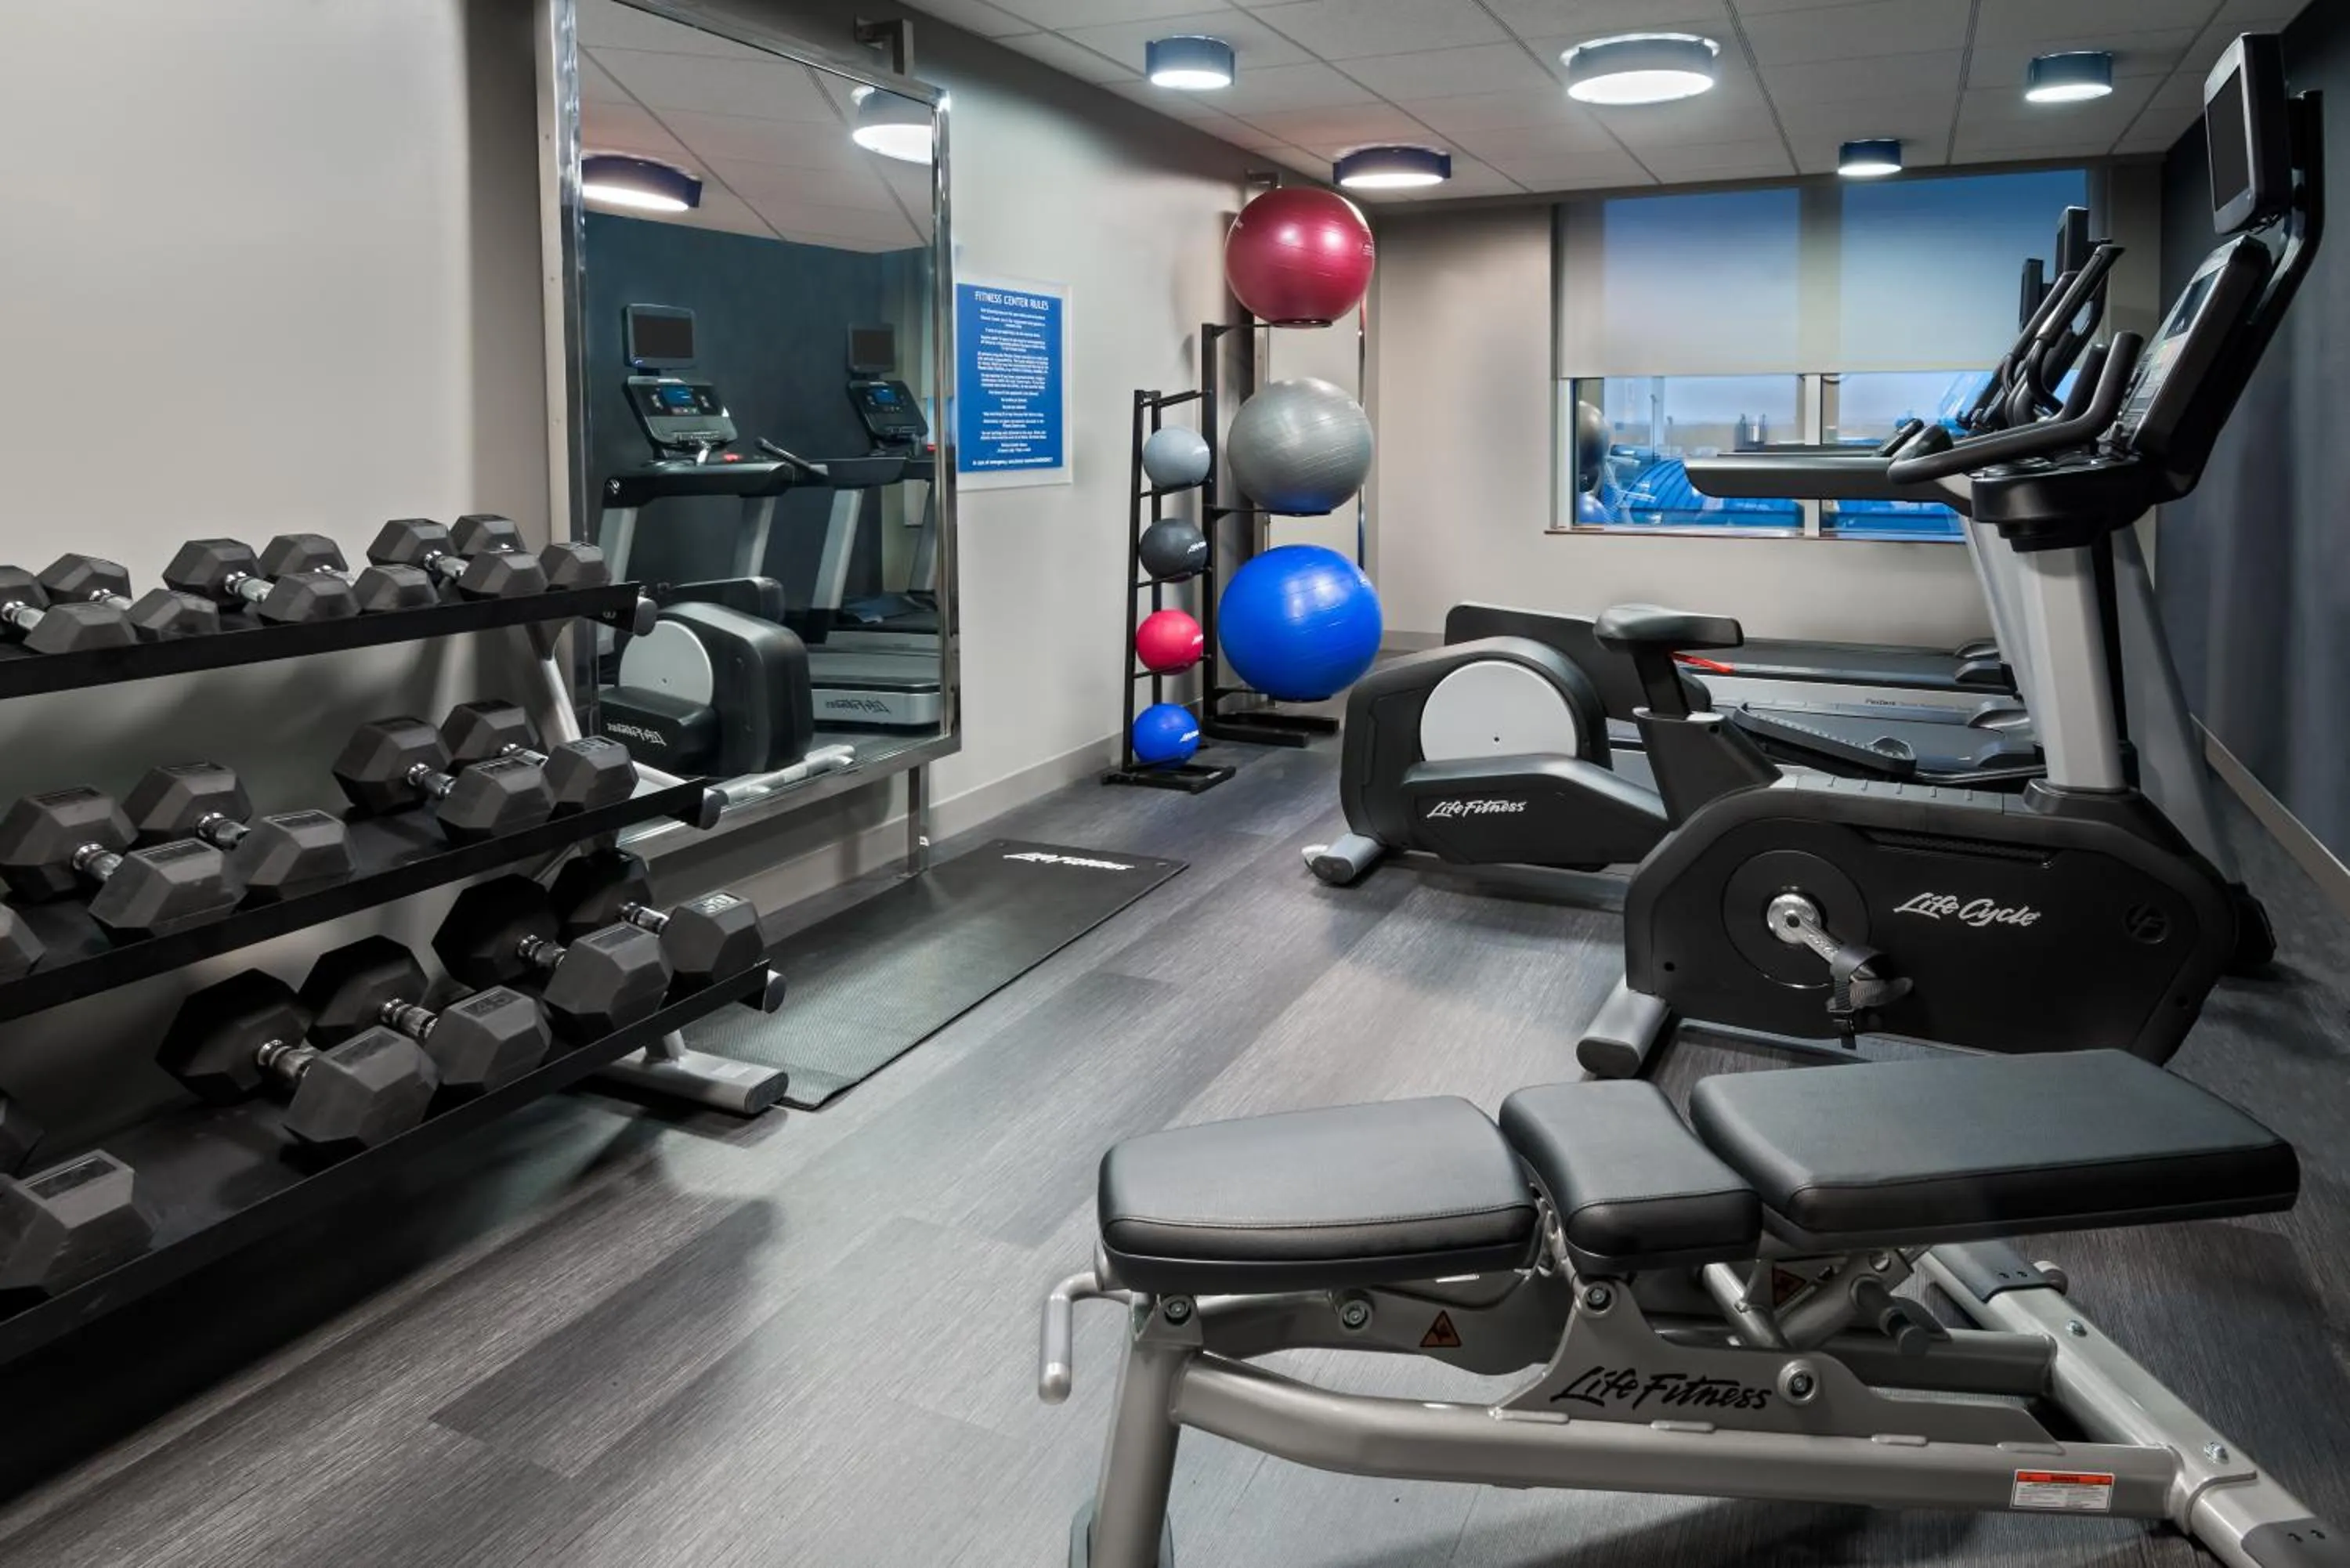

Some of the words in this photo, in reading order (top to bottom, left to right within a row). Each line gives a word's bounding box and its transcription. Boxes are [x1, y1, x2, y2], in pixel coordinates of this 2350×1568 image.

[974, 291, 1002, 305] FITNESS
[1003, 295, 1029, 308] CENTER
[1029, 298, 1049, 310] RULES
[1426, 800, 1463, 818] Life
[1462, 800, 1527, 817] Fitness
[1893, 892, 1959, 919] Life
[1958, 898, 2041, 927] Cycle
[1550, 1365, 1639, 1407] Life
[1632, 1373, 1772, 1410] Fitness
